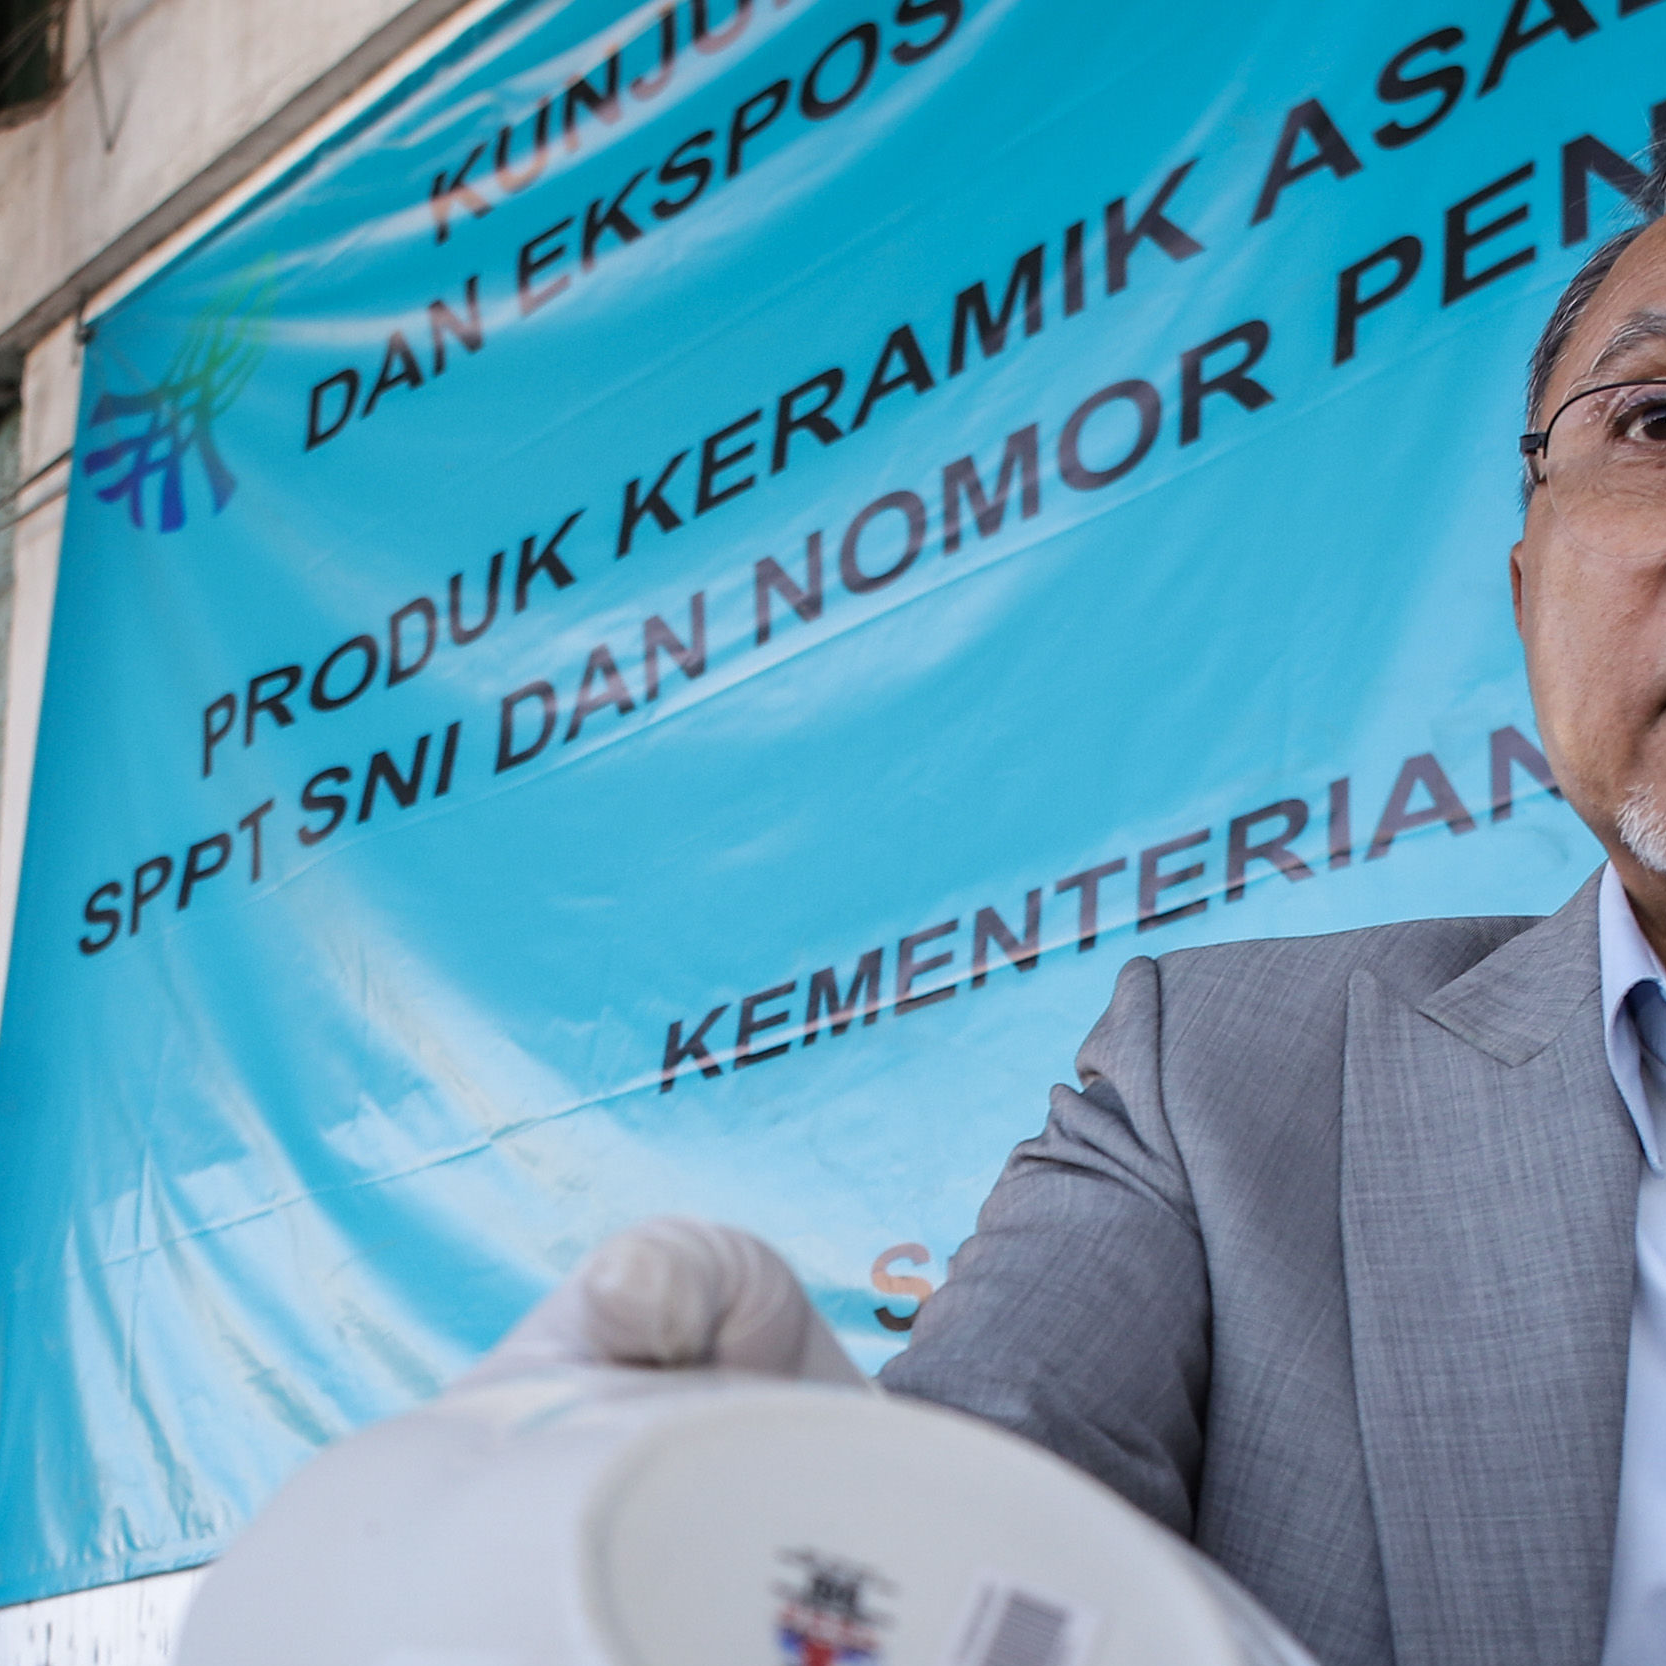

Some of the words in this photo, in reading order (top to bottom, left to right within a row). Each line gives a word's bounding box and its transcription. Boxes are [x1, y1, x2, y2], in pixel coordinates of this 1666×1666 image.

[303, 275, 484, 453] DAN
[515, 0, 964, 317] EKSPOS
[428, 0, 789, 245] KUNJU
[77, 797, 276, 956] SPPT
[297, 720, 462, 846] SNI
[494, 591, 710, 776] DAN
[753, 318, 1276, 648] NOMOR
[200, 507, 589, 779] PRODUK
[614, 157, 1204, 561] KERAMIK
